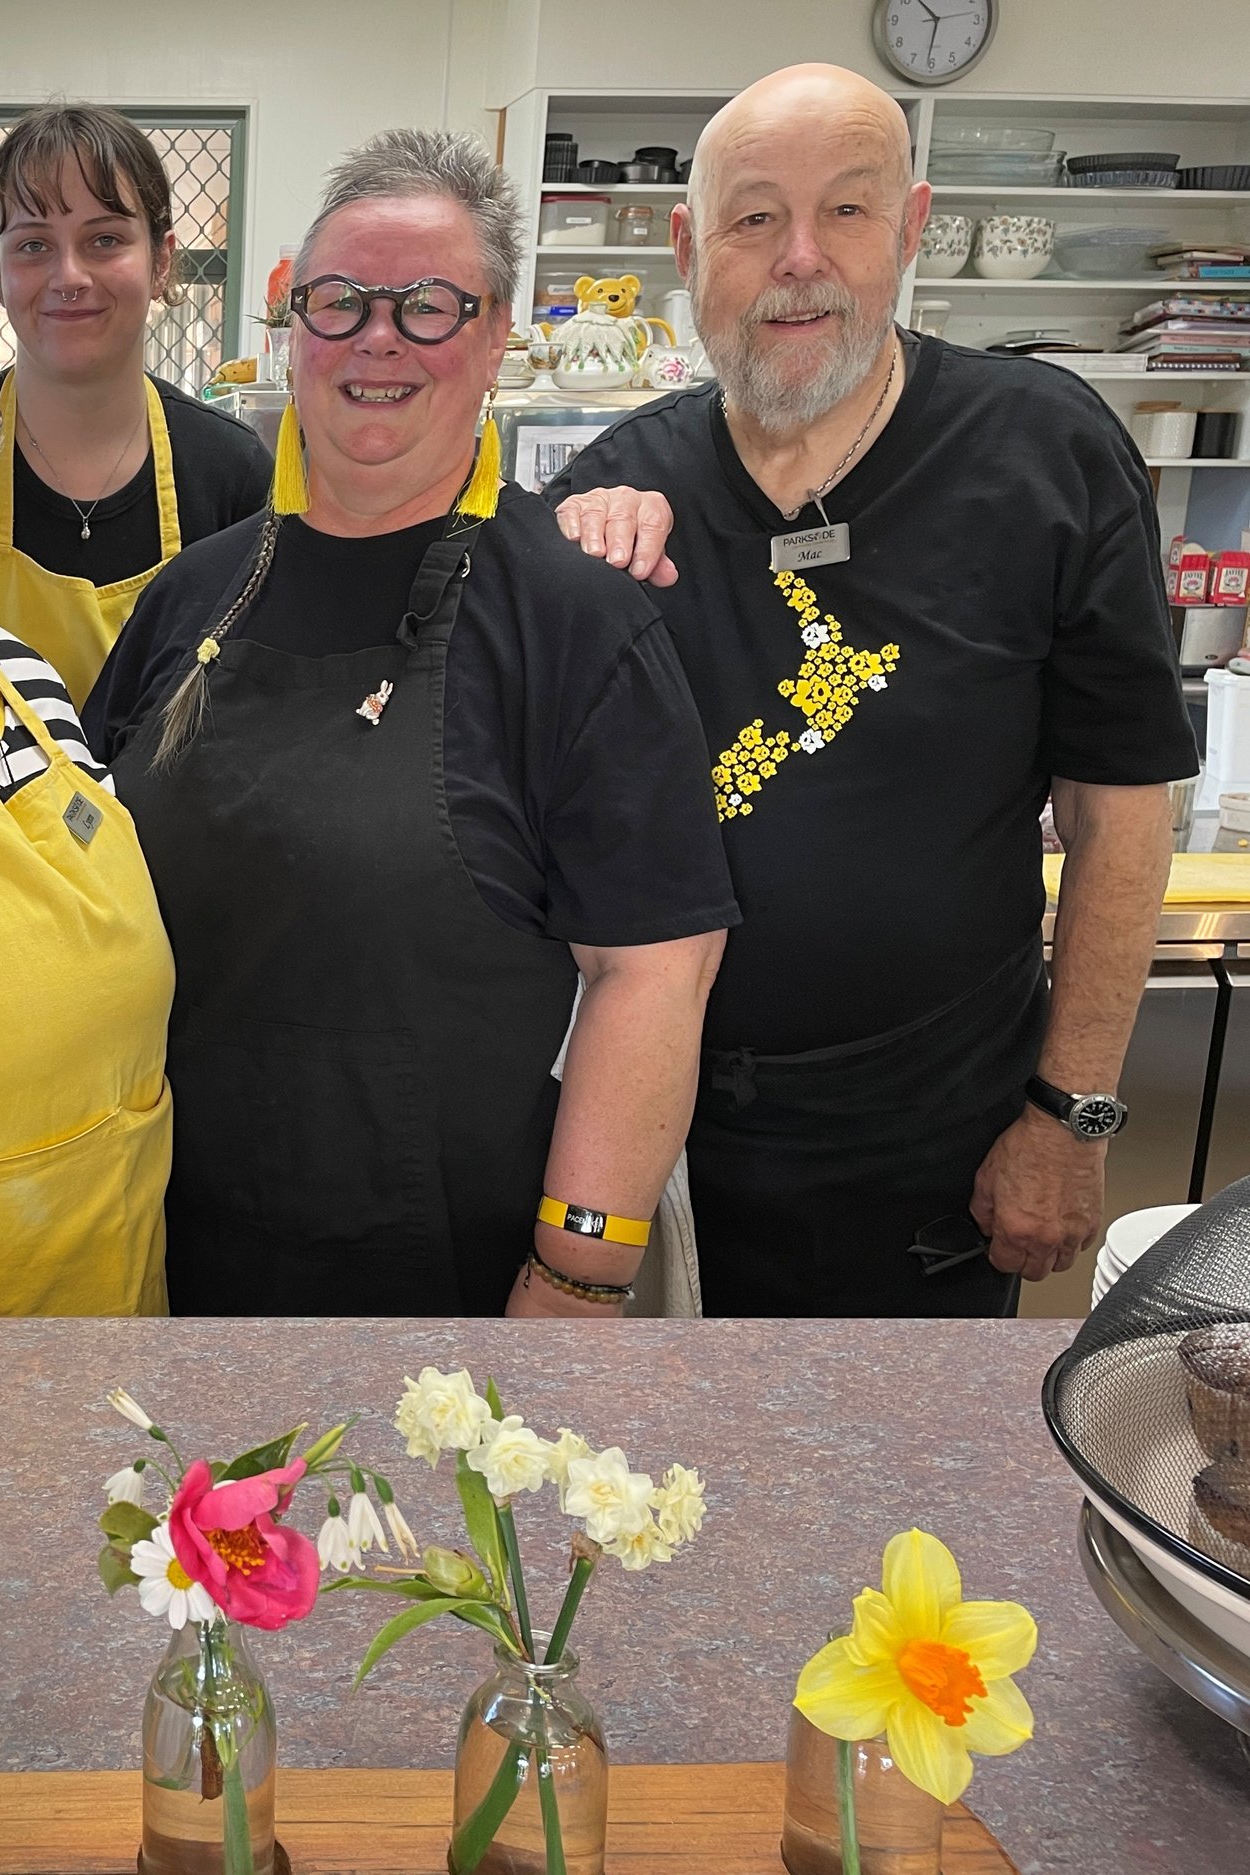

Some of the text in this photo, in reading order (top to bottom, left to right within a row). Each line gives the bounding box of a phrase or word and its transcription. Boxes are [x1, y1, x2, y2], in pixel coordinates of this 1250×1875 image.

[891, 14, 899, 26] 9
[973, 14, 980, 25] 3
[895, 37, 903, 48] 8
[964, 37, 972, 47] 4
[910, 53, 917, 64] 7
[948, 52, 956, 63] 5
[928, 58, 935, 69] 6
[797, 550, 823, 563] Mac
